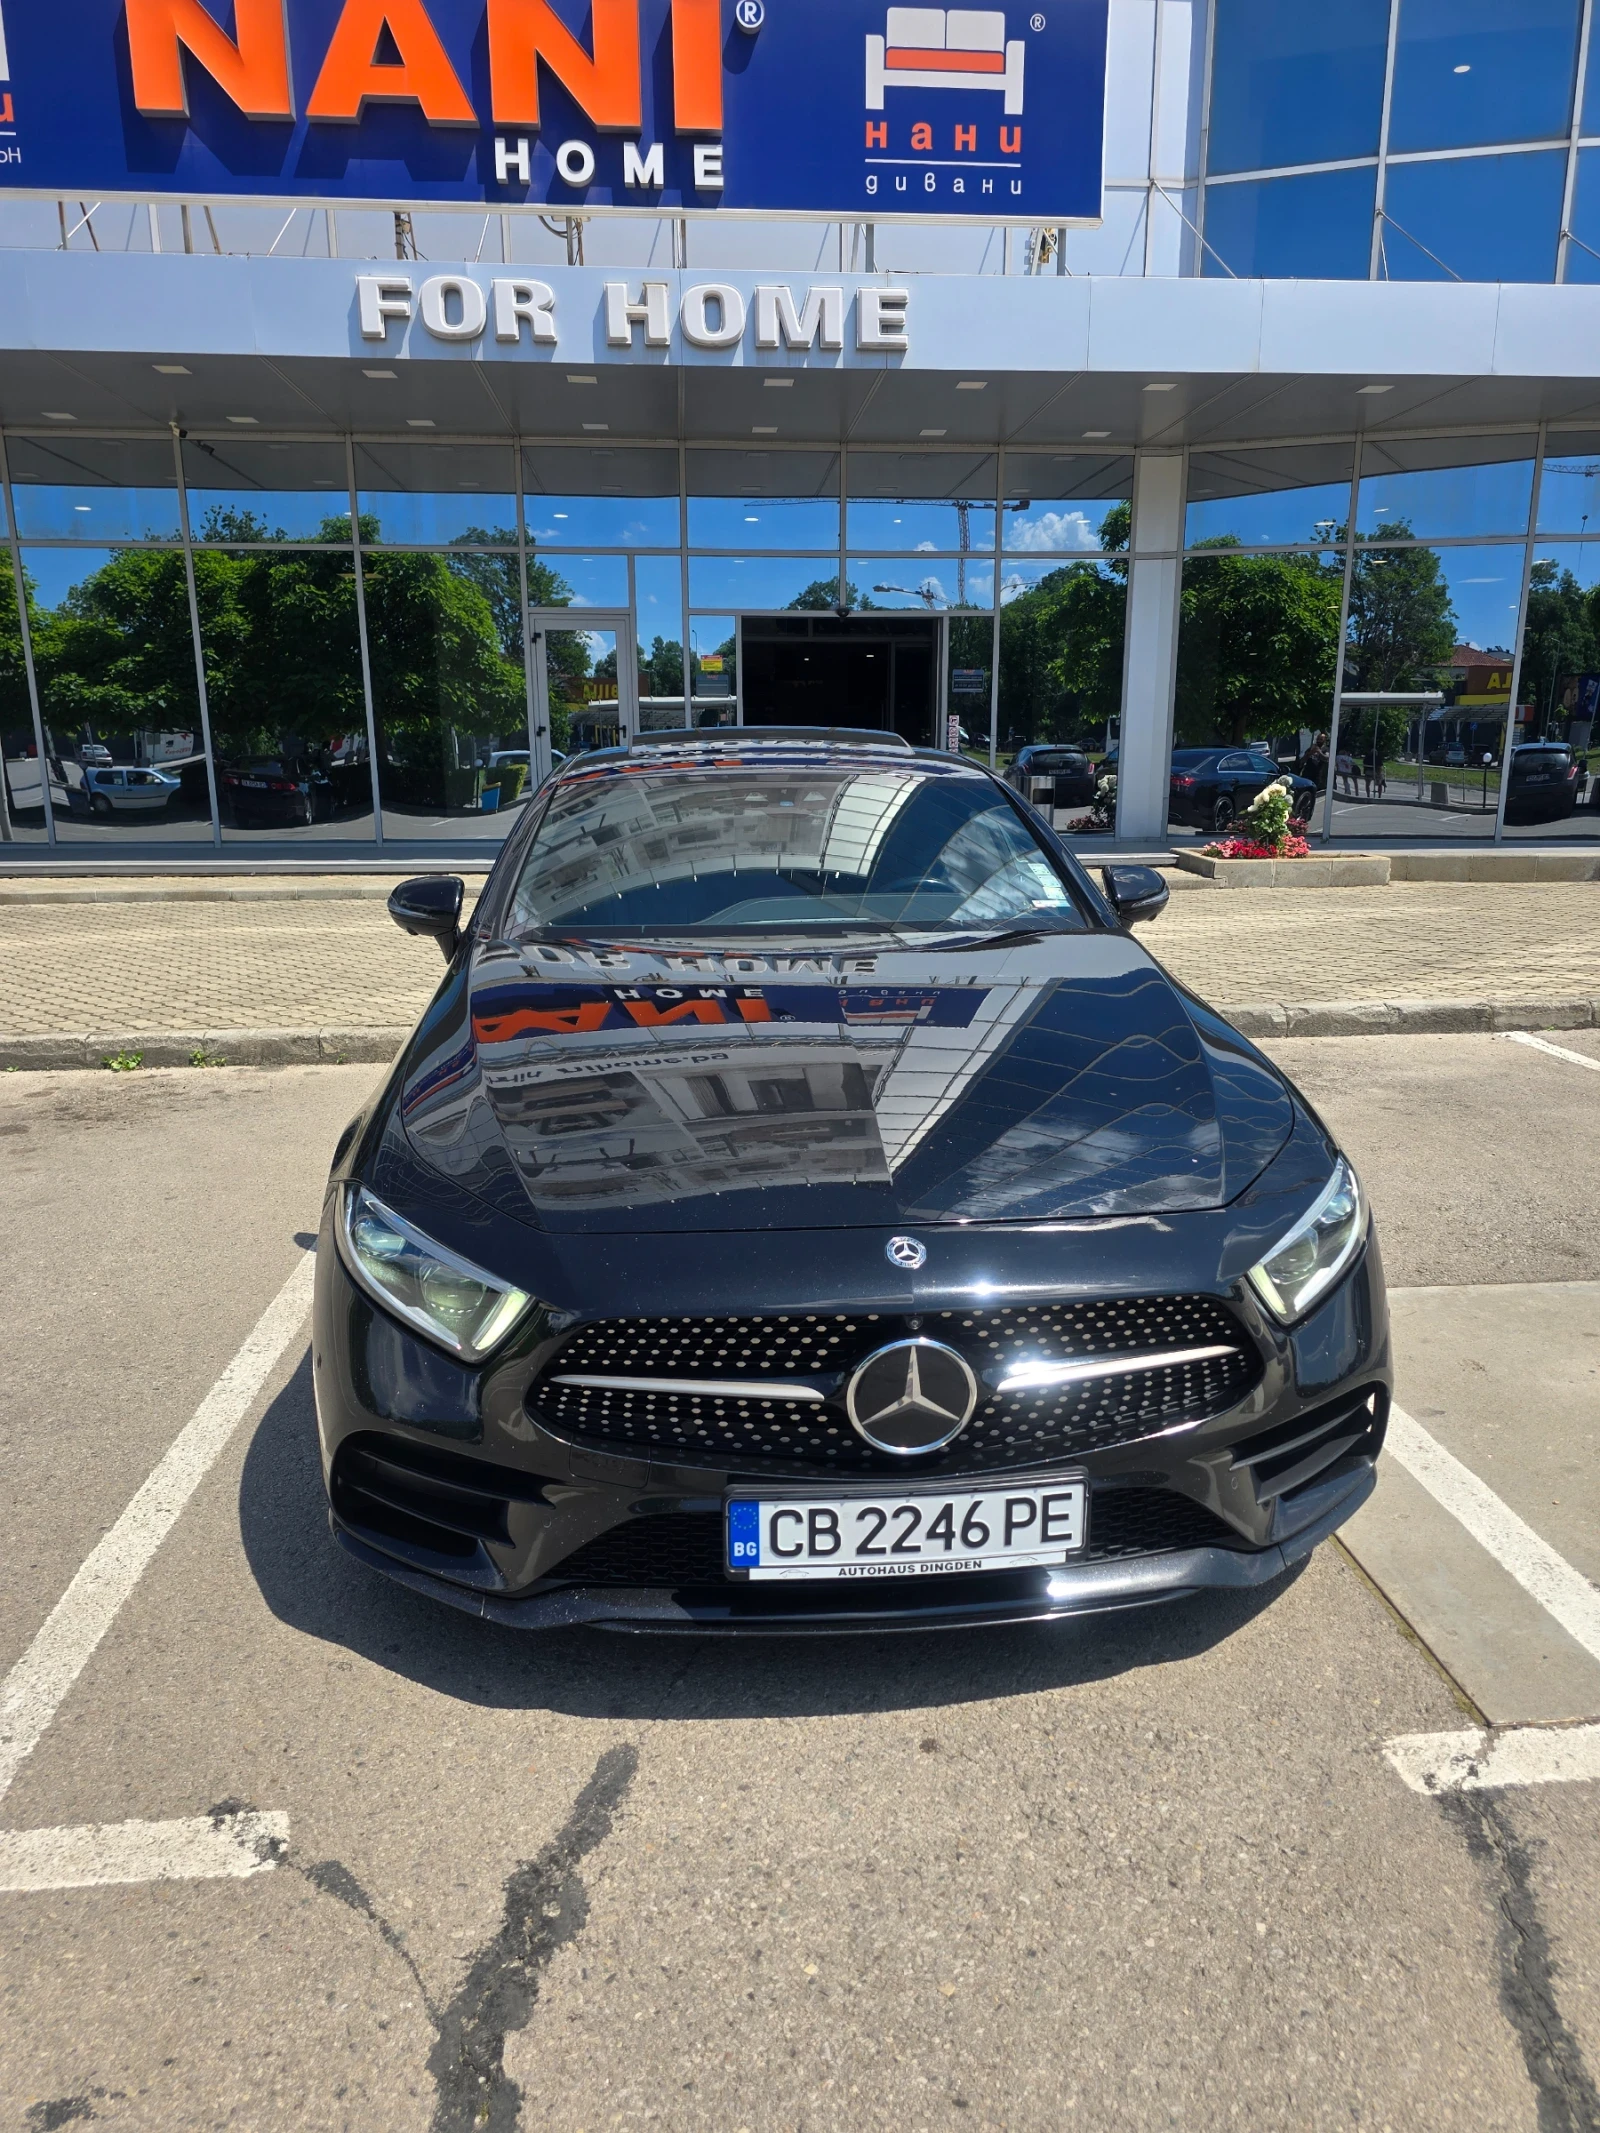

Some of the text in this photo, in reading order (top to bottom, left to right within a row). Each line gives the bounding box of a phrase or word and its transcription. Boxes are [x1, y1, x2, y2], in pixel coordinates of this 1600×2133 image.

[125, 0, 723, 136] NANI
[865, 120, 1022, 153] нани
[494, 138, 725, 190] HOME
[865, 172, 1022, 195] дивани
[356, 274, 909, 351] FOR HOME
[769, 1492, 1073, 1557] CB 2246 PE
[733, 1541, 757, 1557] BG
[838, 1560, 982, 1576] AUTOHAUS DINGDEN
